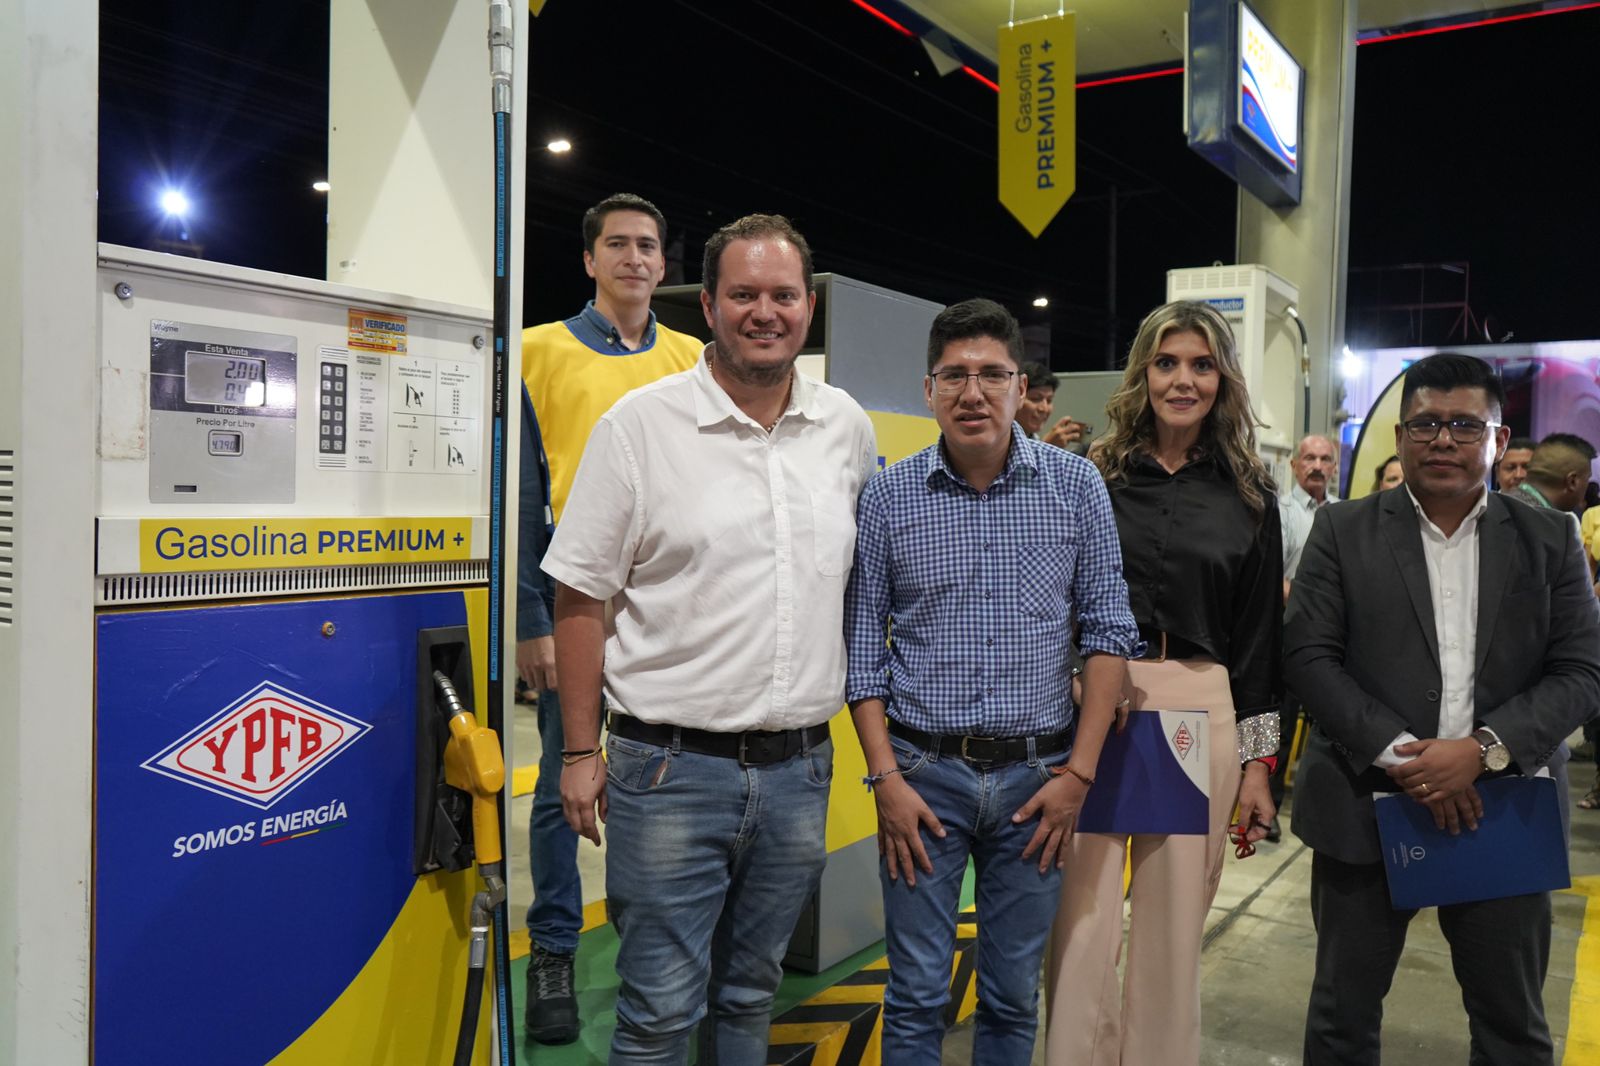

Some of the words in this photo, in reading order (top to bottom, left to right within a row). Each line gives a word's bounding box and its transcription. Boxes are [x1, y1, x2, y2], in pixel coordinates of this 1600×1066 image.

[1015, 43, 1033, 133] Gasolina
[1037, 61, 1055, 190] PREMIUM
[364, 319, 406, 333] VERIFICADO
[204, 344, 224, 354] Esta
[225, 346, 249, 356] Venta
[224, 360, 259, 381] 2.00
[214, 405, 239, 415] Litros
[196, 417, 221, 427] Precio
[223, 419, 236, 428] Por
[155, 525, 308, 561] Gasolina
[317, 529, 445, 554] PREMIUM
[203, 707, 322, 784] YPFB
[1176, 729, 1190, 752] YPFB
[171, 821, 255, 858] SOMOS
[260, 799, 348, 838] ENERGÍA
